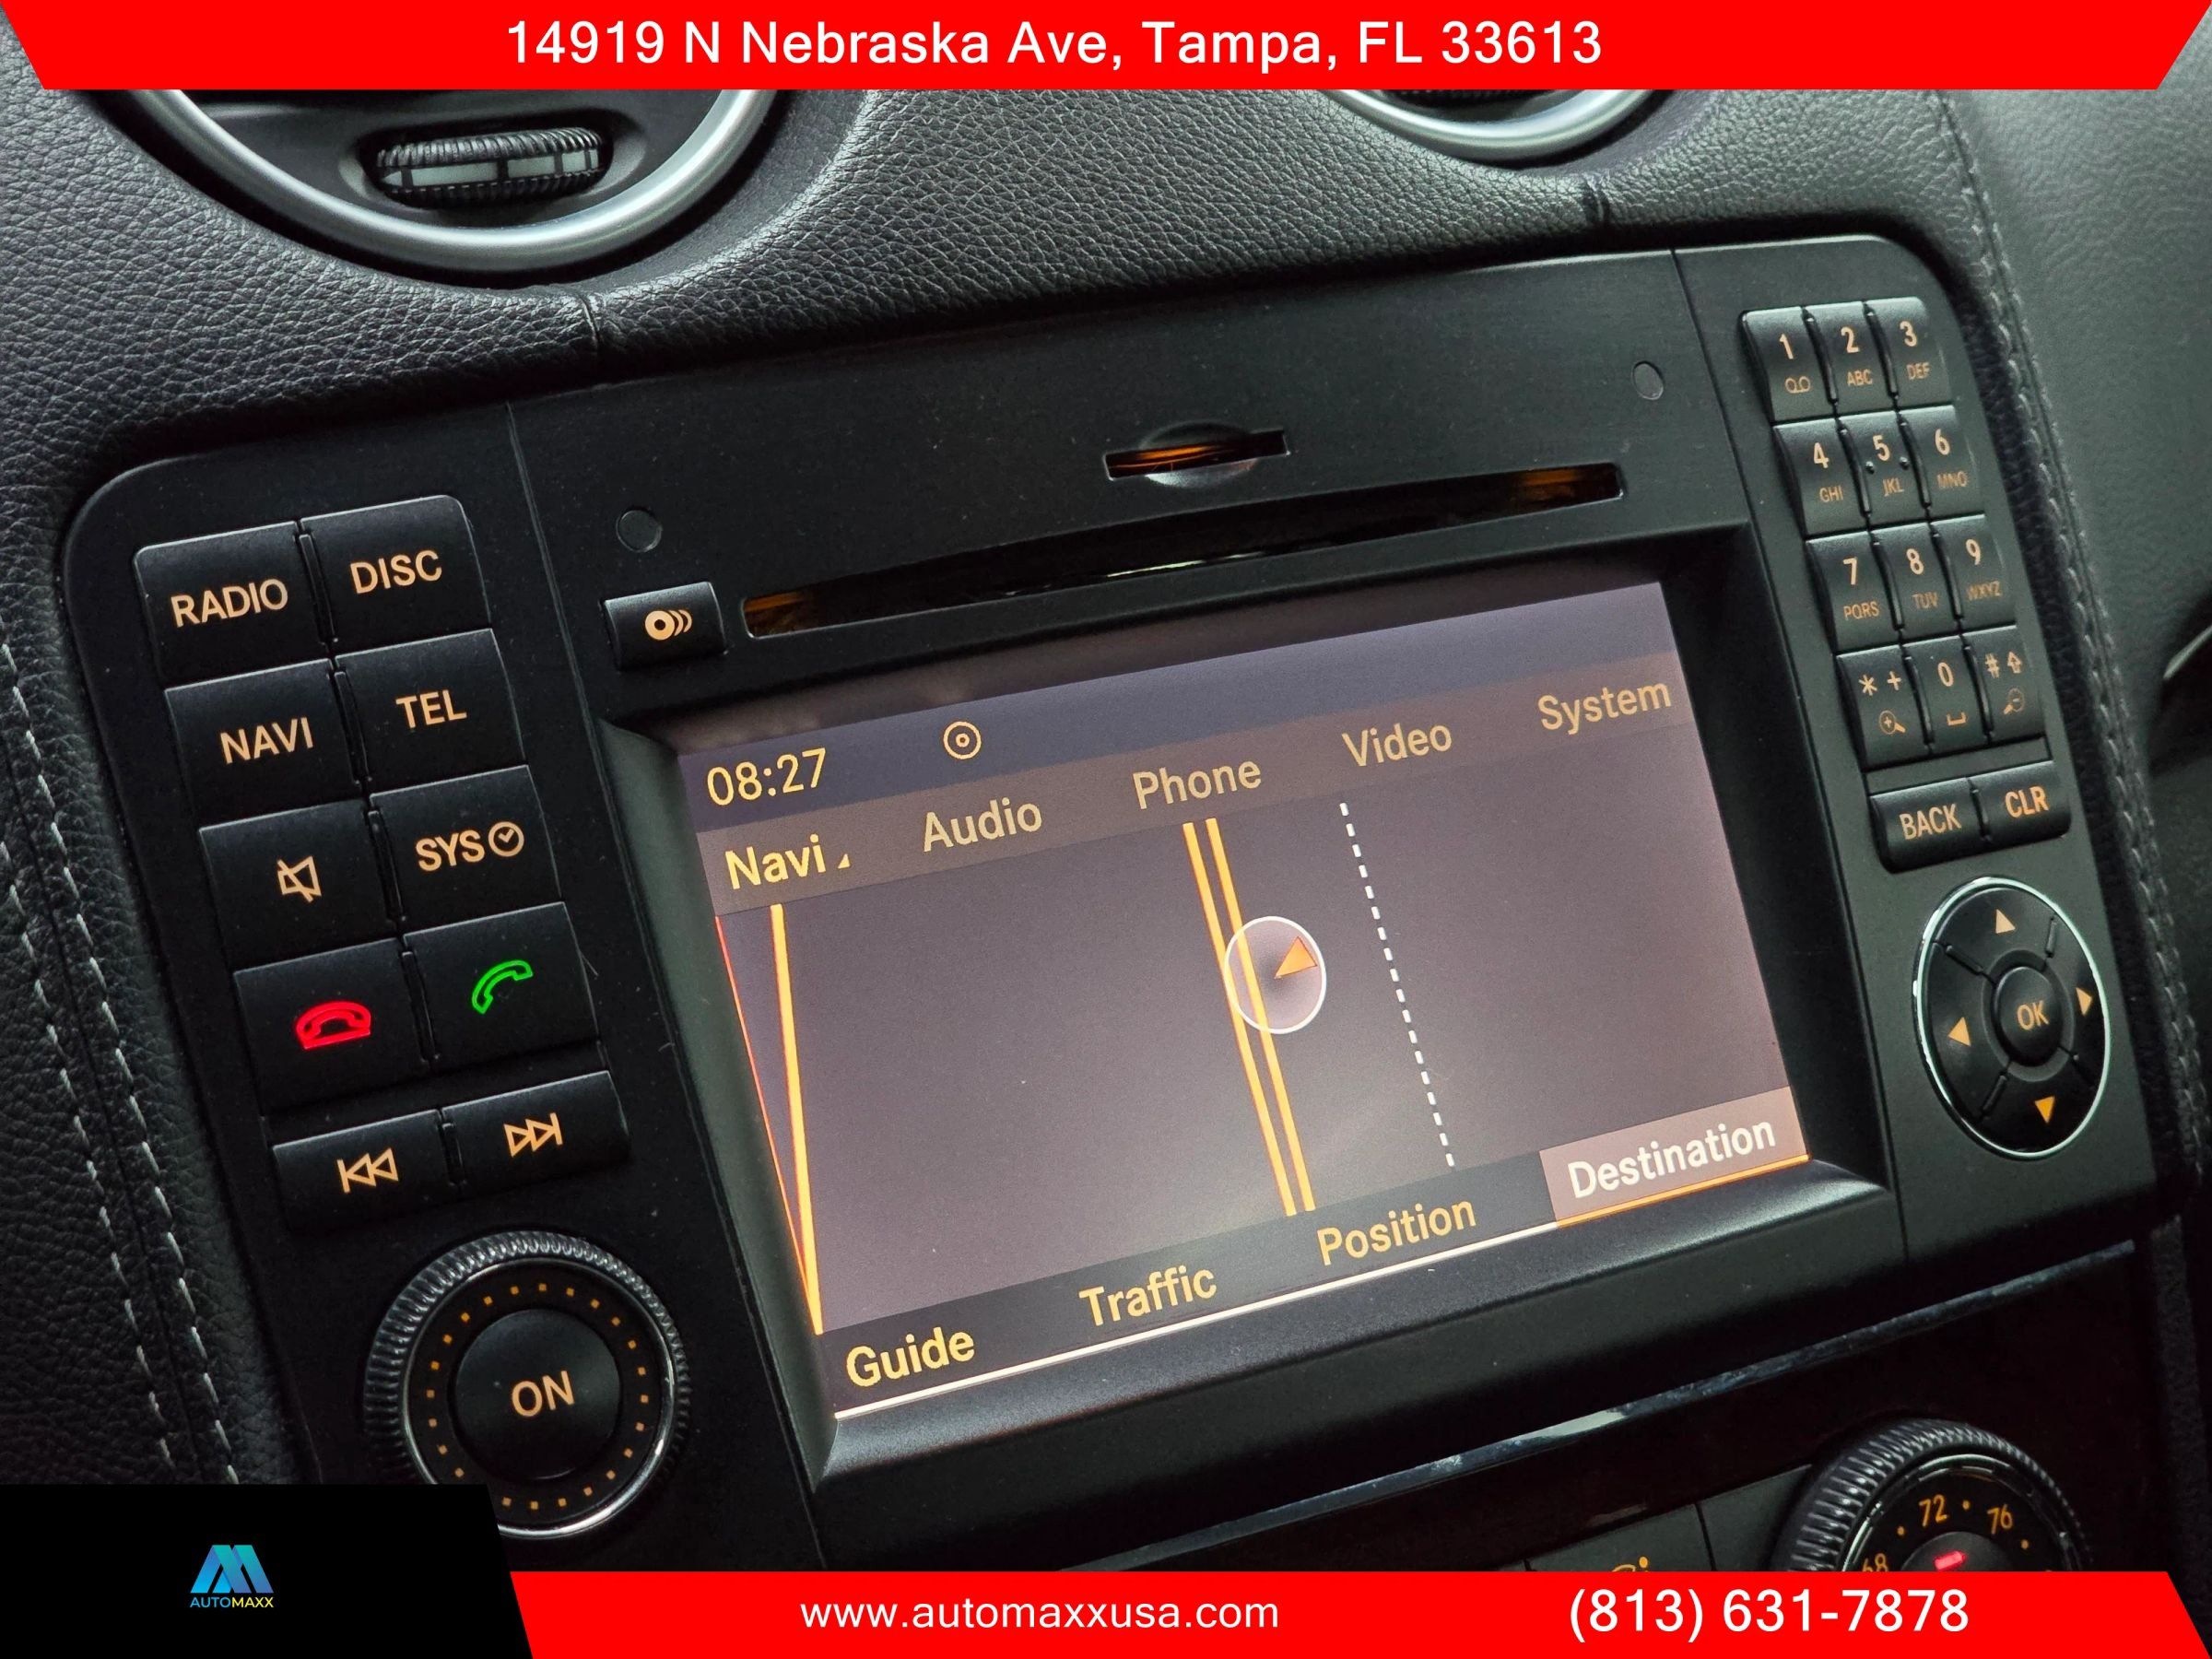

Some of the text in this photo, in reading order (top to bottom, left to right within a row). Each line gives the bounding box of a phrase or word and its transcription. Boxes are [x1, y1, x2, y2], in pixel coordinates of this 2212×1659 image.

[1779, 334, 1795, 359] 1
[1841, 325, 1859, 354] 2
[1900, 320, 1918, 347] 3
[1846, 368, 1874, 387] ABC
[1906, 361, 1931, 381] DEF
[1812, 441, 1830, 469] 4
[1872, 434, 1892, 463] 5
[1934, 429, 1951, 457] 6
[1818, 484, 1844, 503] GHI
[1882, 478, 1906, 498] JKL
[1937, 469, 1969, 489] MNO
[1906, 547, 1925, 576] 8
[1965, 538, 1983, 567] 9
[349, 548, 442, 594] DISC
[1842, 556, 1859, 585] 7
[171, 579, 288, 627] RADIO
[1843, 600, 1881, 621] PQRS
[396, 688, 466, 728] TEL
[219, 716, 313, 764] NAVI
[706, 747, 827, 806] 08:27
[724, 683, 1671, 889] Navi Audio Phone Video System
[2005, 785, 2050, 818] CLR
[1899, 803, 1963, 841] BACK
[415, 829, 486, 872] SYS
[2016, 1000, 2050, 1031] OK
[844, 1121, 1776, 1388] Guide Traffic Position Destination
[511, 1371, 575, 1417] ON
[1918, 1494, 1950, 1528] 72
[1986, 1502, 2014, 1535] 76
